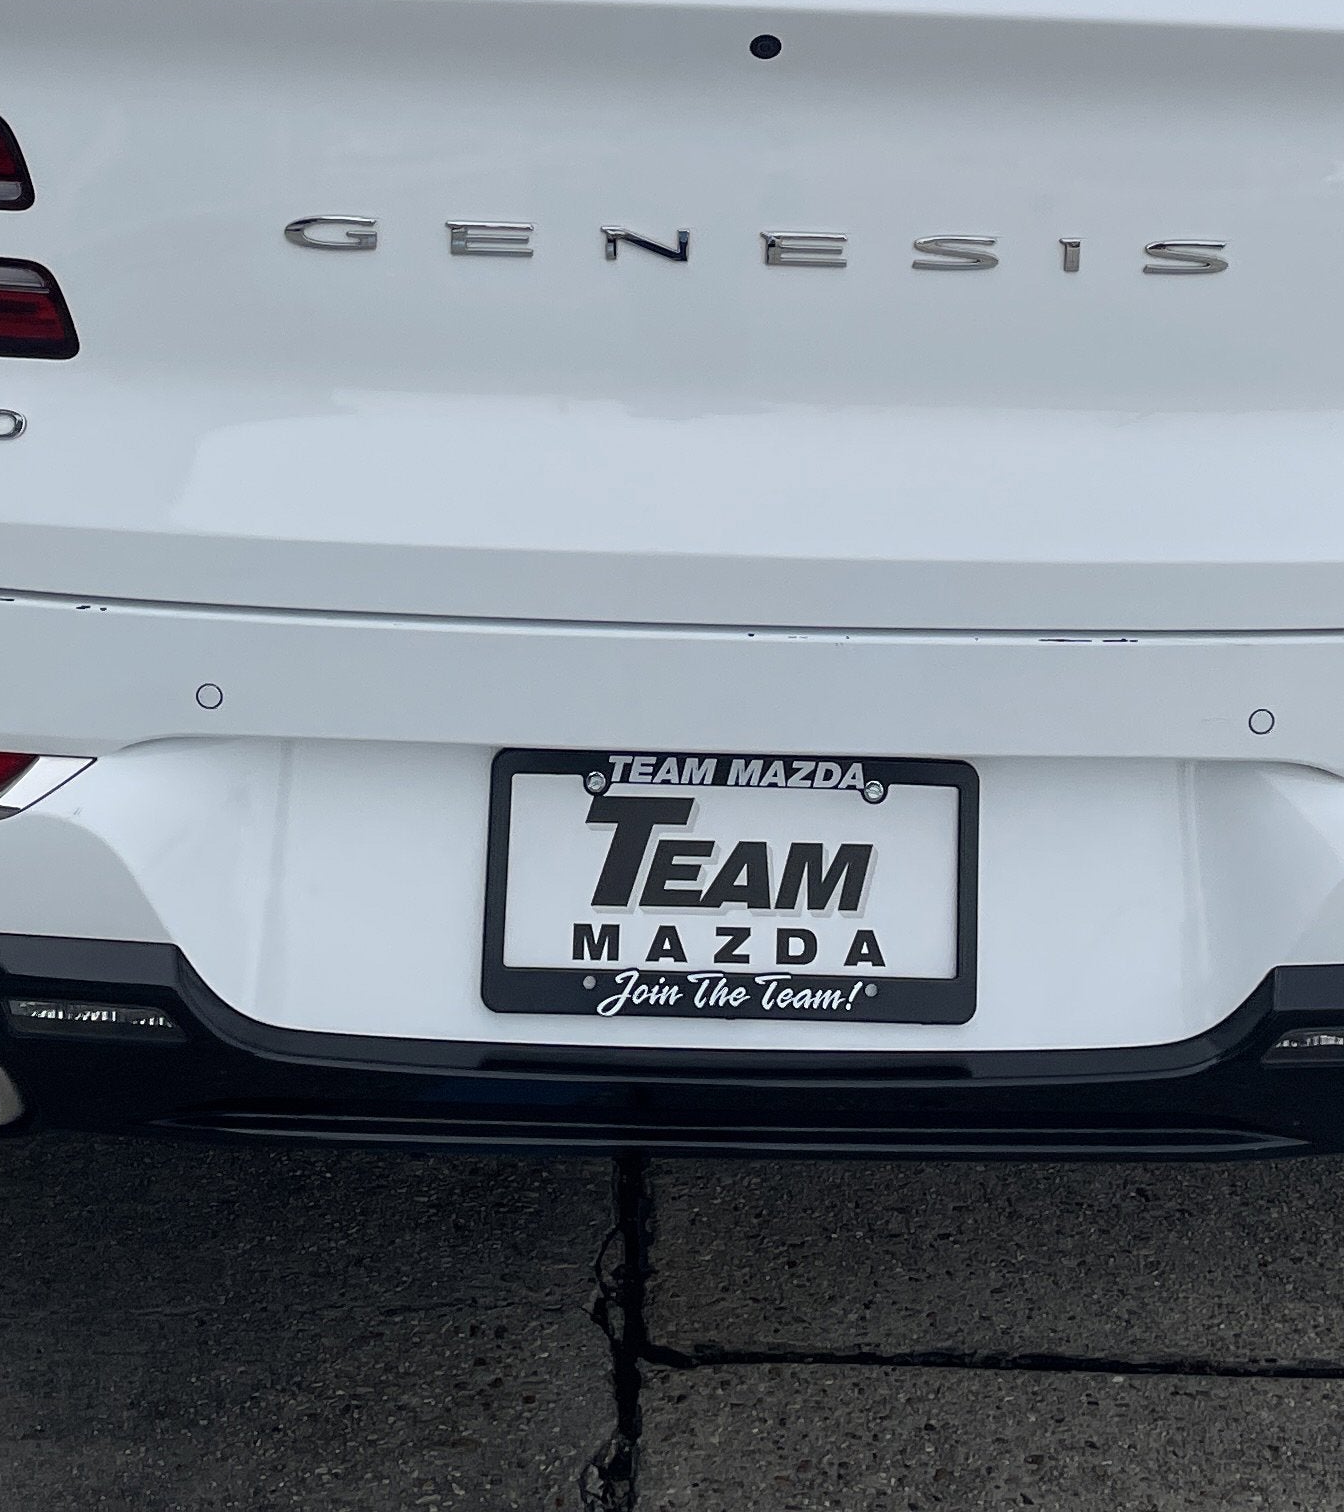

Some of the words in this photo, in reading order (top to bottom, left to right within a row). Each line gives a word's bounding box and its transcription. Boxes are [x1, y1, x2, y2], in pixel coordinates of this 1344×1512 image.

[283, 214, 1230, 276] GENESIS
[609, 755, 718, 785] TEAM
[727, 758, 865, 790] MAZDA
[585, 795, 878, 917] TEAM
[571, 923, 886, 968] MAZDA
[597, 969, 682, 1017] Join
[686, 972, 750, 1009] The
[755, 976, 862, 1012] Team!
